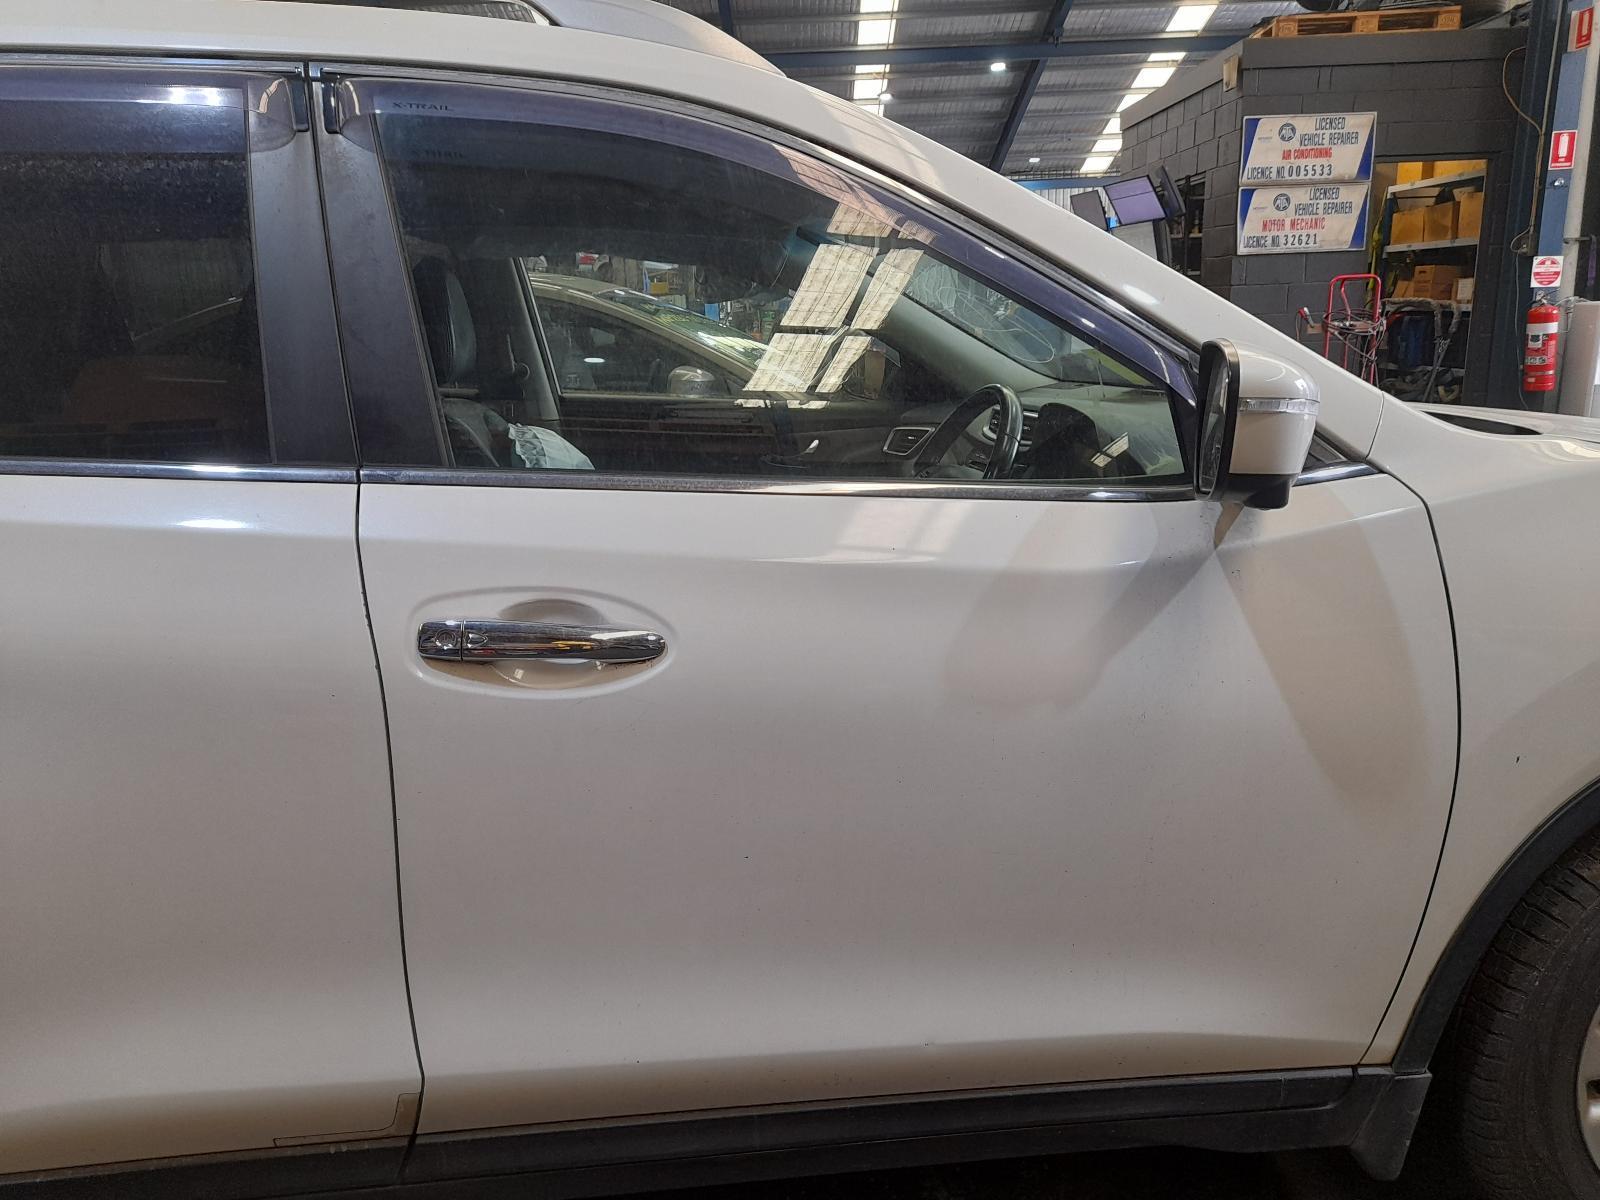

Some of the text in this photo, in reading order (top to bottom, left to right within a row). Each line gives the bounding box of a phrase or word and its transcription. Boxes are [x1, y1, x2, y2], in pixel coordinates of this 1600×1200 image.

[392, 102, 454, 111] X-TRAIL
[1315, 117, 1346, 131] LICENSED
[1300, 132, 1359, 147] VEHICLE REPAIRER
[1282, 147, 1332, 160] AIR CONDITIONING
[1247, 166, 1273, 180] LICENCE
[1309, 187, 1340, 200] LICENSED
[1295, 202, 1353, 215] VEHICLE REPAIRER
[1262, 217, 1325, 232] MOTOR MECHANIC
[1243, 235, 1268, 248] LICENCE
